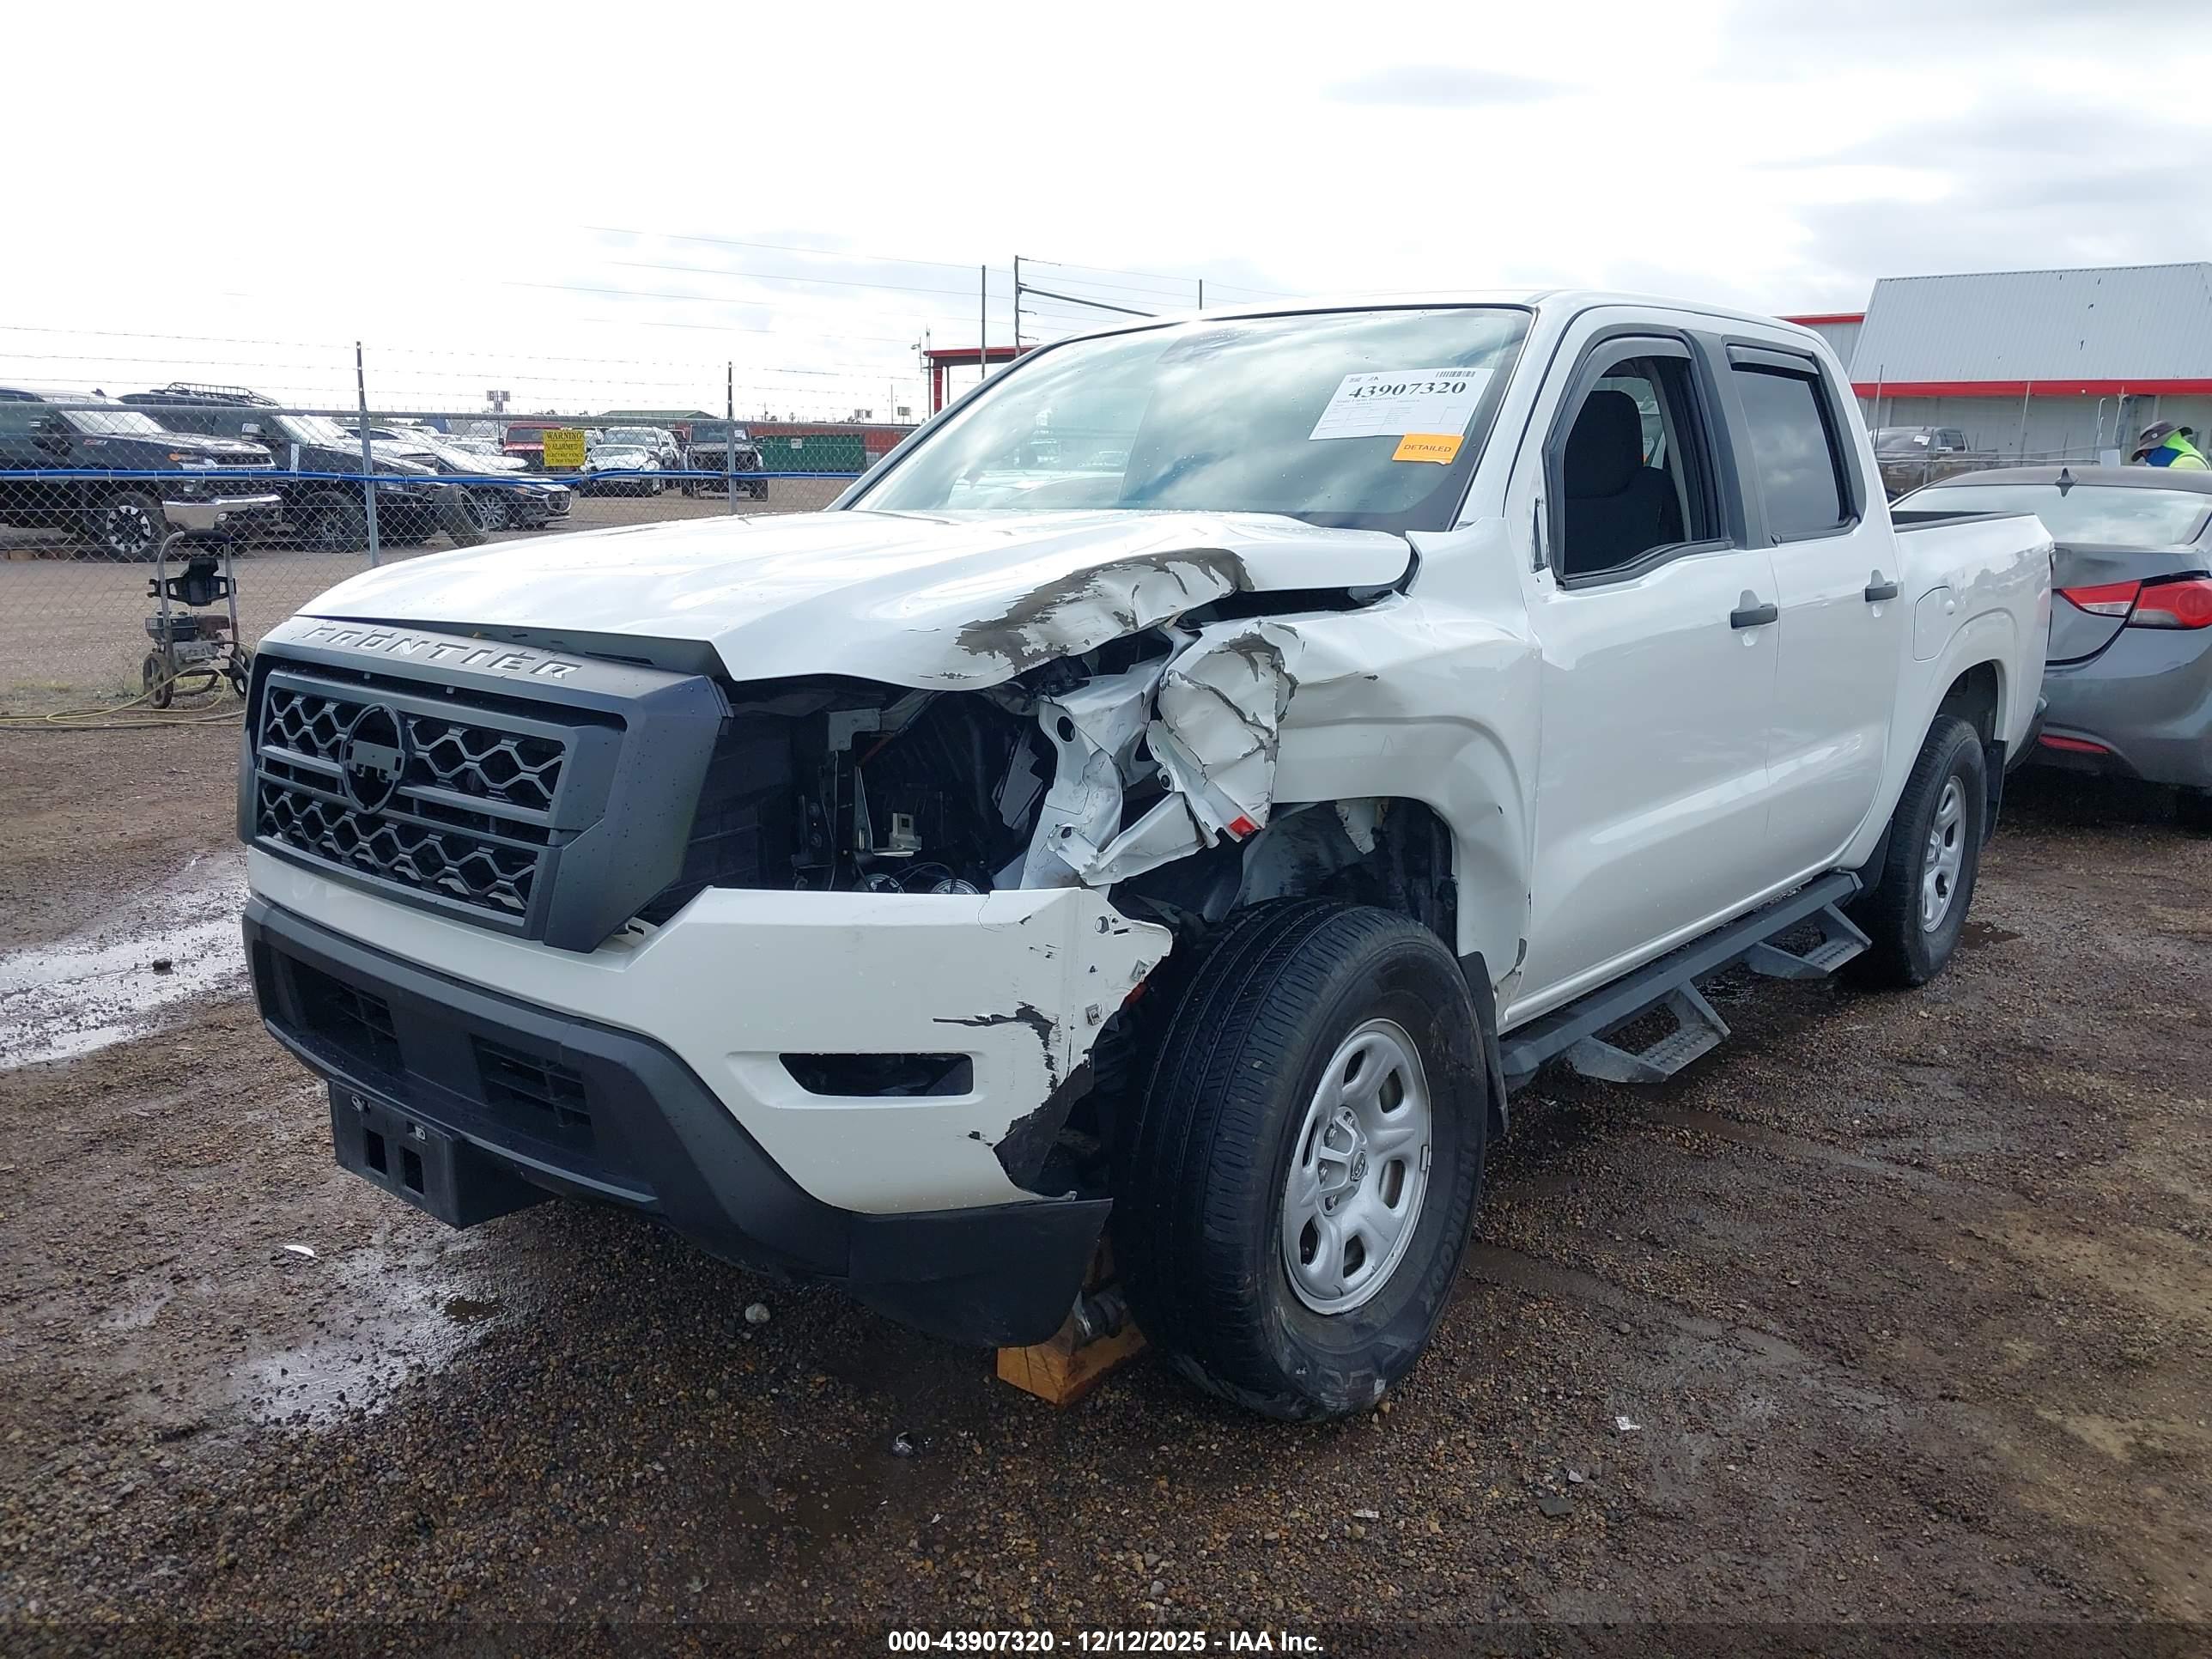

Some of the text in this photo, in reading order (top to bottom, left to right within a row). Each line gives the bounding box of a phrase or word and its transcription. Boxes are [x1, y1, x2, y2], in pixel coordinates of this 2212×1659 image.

[1349, 382, 1467, 398] 43907320
[546, 431, 582, 440] WARNING
[1403, 443, 1451, 453] DETAILED
[302, 626, 583, 678] FRONTIER
